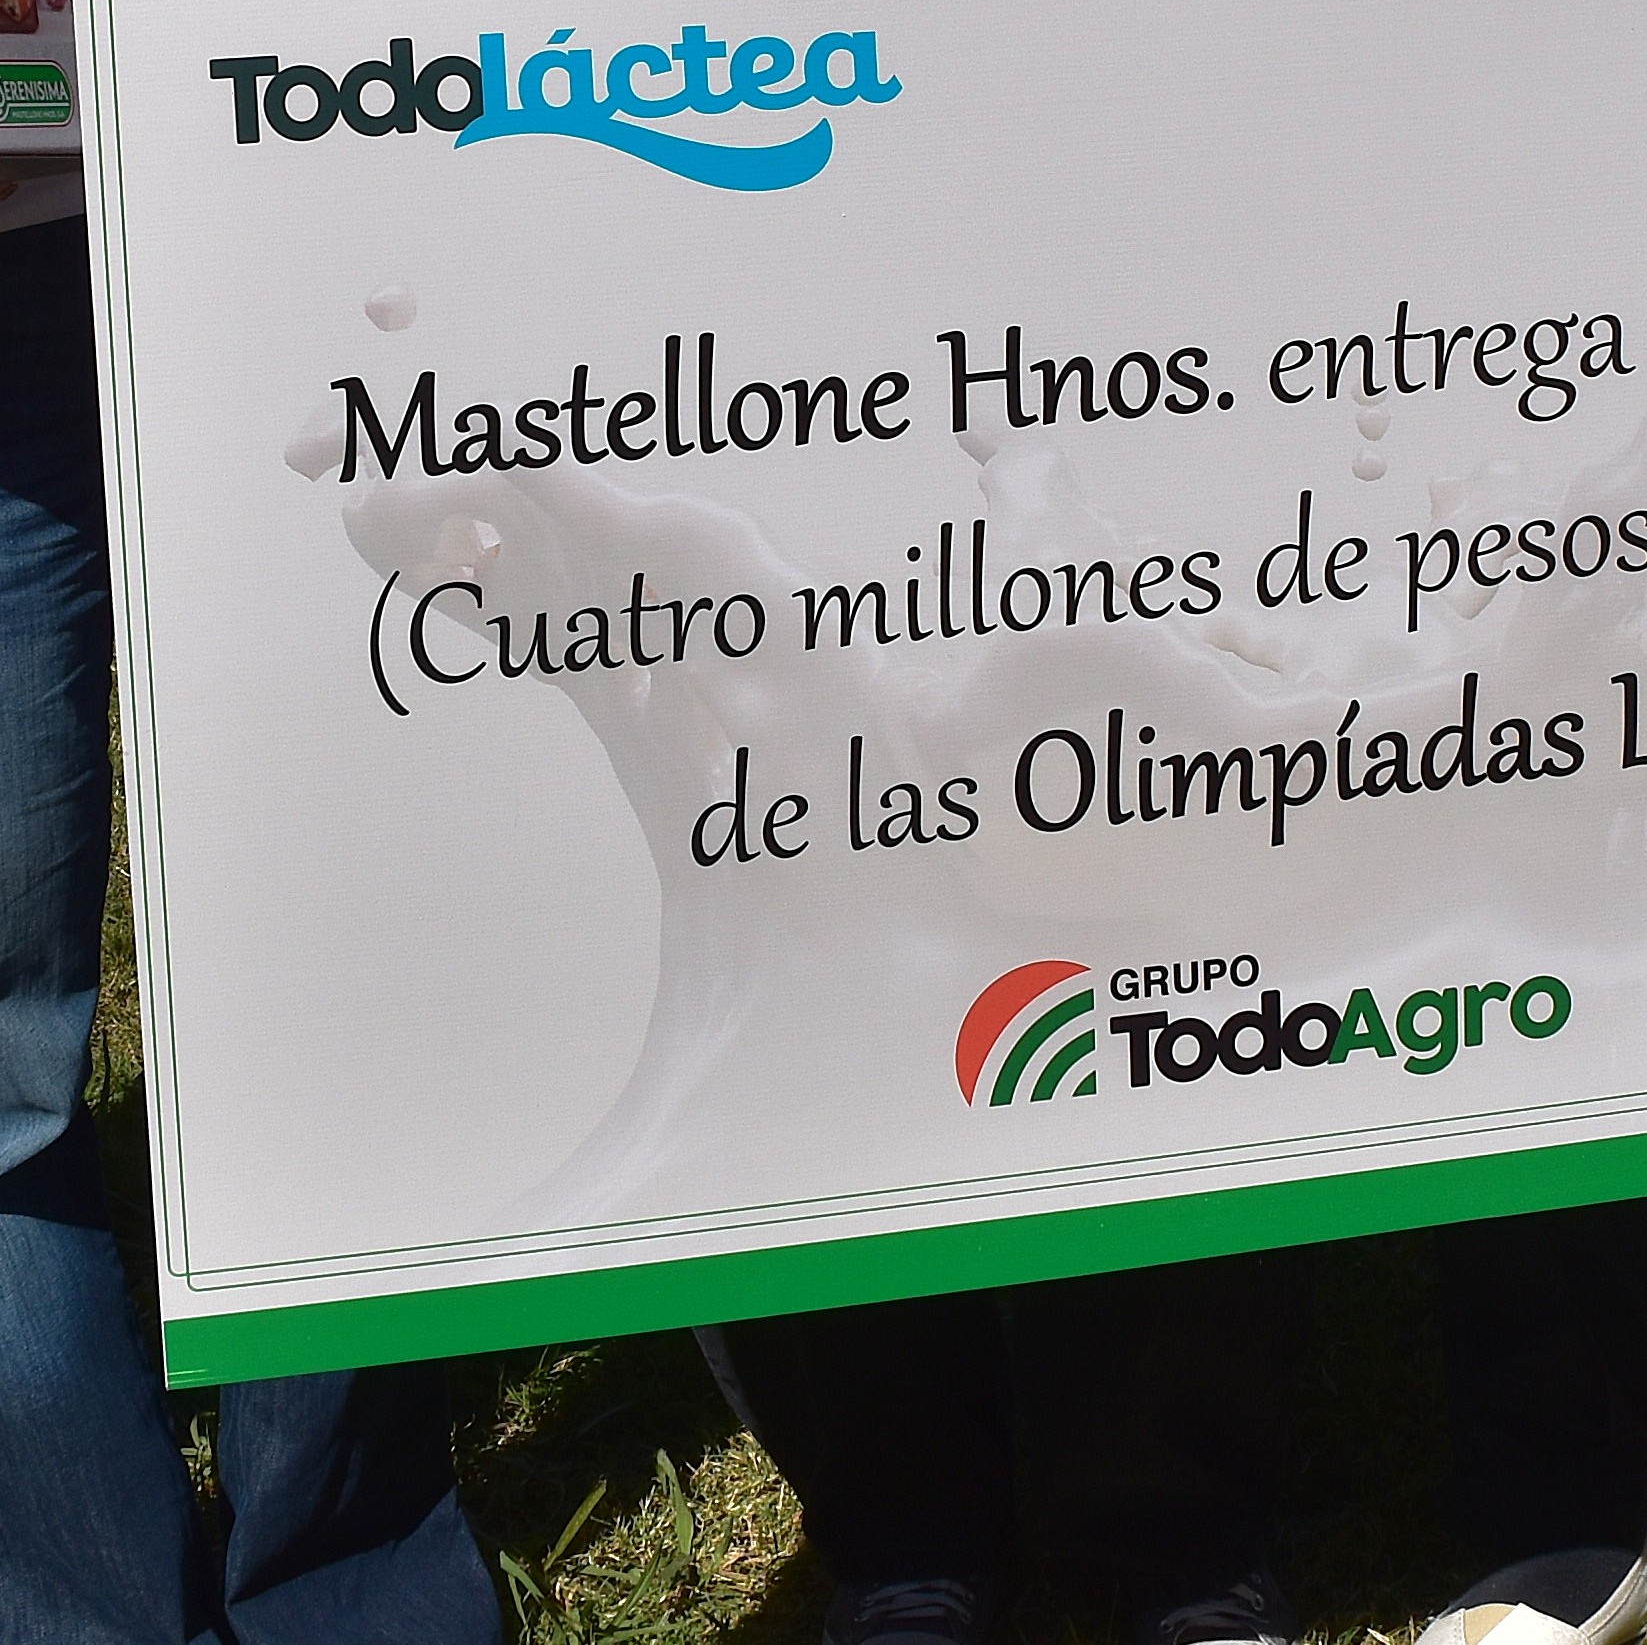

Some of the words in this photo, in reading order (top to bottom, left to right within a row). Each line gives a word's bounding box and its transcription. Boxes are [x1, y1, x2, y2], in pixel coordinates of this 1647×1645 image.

[329, 331, 912, 484] Mastellone
[935, 325, 1236, 435] Hnos.
[1267, 300, 1637, 422] entrega
[369, 569, 768, 718] (Cuatro
[792, 518, 1223, 653] millones
[1254, 489, 1370, 609] de
[689, 746, 810, 868] de
[847, 735, 981, 853] las
[1013, 671, 1586, 848] Olimpíadas
[1109, 973, 1574, 1089] TodoAgro
[1110, 953, 1260, 1003] GRUPO
